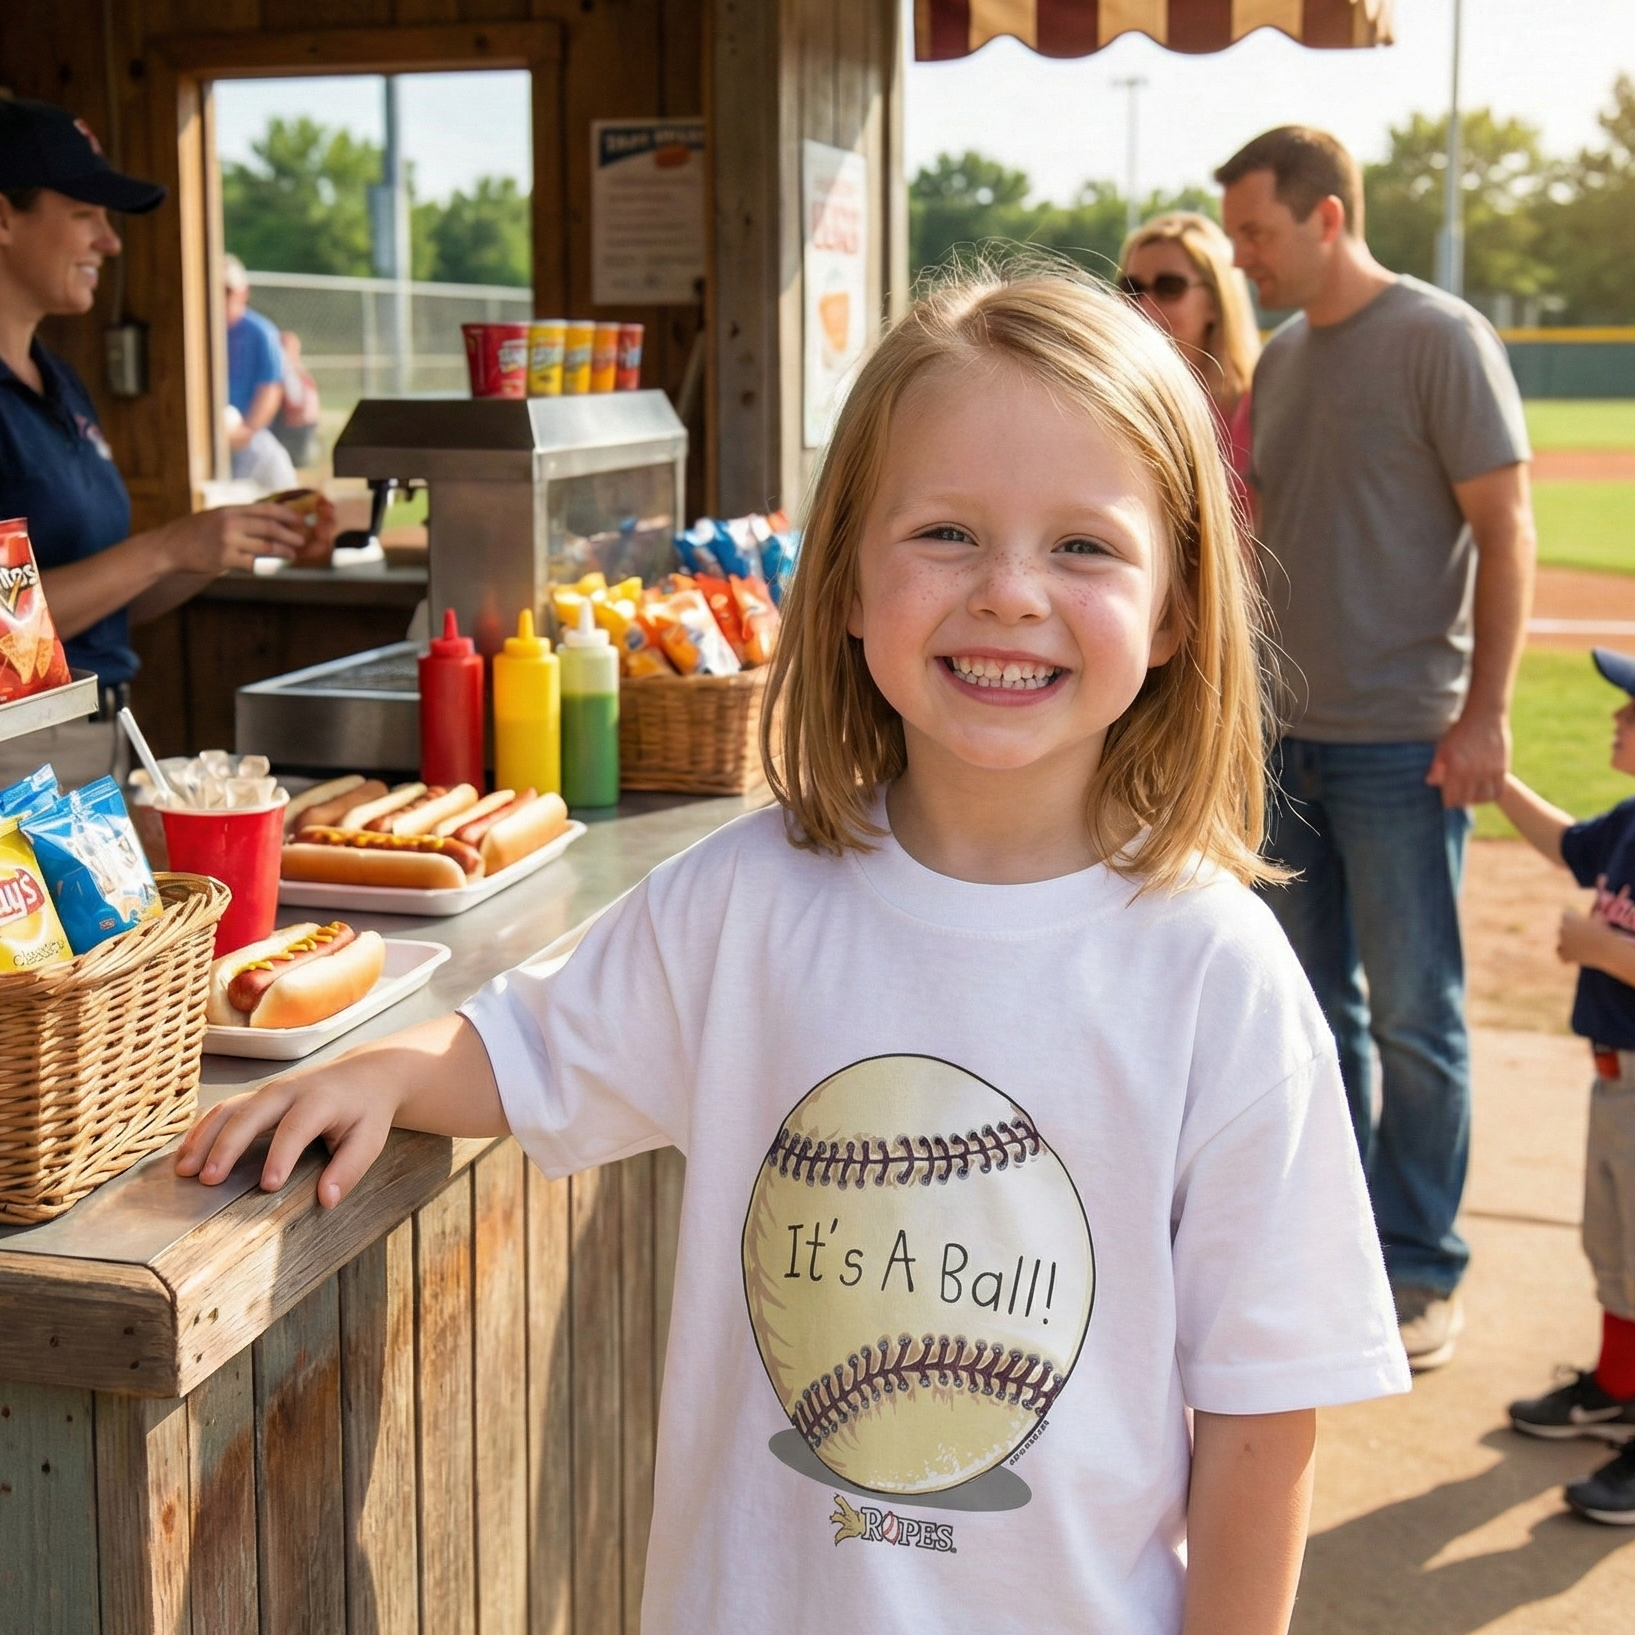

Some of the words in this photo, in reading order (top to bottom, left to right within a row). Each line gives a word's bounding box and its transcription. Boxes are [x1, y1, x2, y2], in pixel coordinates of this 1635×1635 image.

[783, 1217, 864, 1287] It's
[880, 1229, 916, 1293] A
[940, 1242, 1057, 1325] Ball!
